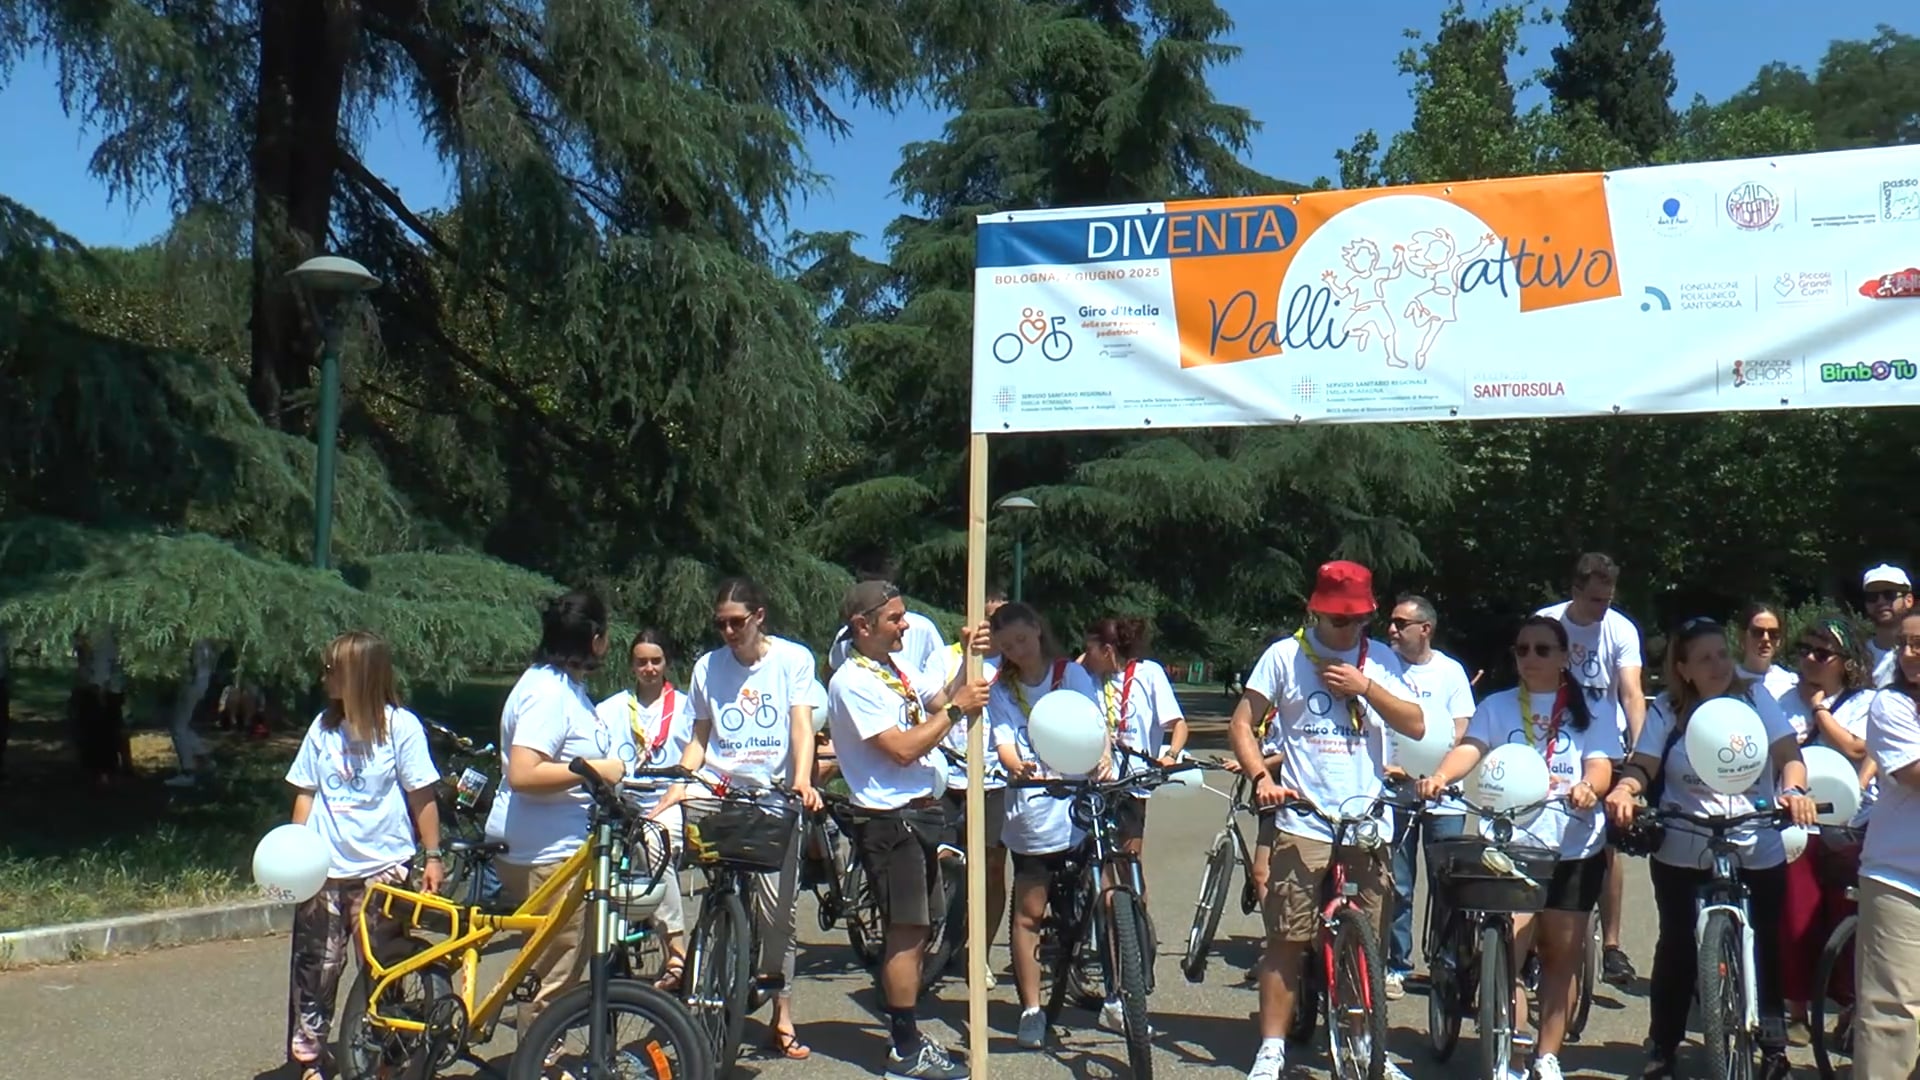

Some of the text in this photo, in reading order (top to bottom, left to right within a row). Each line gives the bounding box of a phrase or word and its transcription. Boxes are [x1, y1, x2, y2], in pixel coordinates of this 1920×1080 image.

[1883, 178, 1919, 191] passo
[1087, 209, 1286, 259] DIVENTA
[1460, 235, 1613, 299] attivo
[1074, 268, 1126, 282] GIUGNO
[1129, 267, 1160, 278] 2025
[1799, 271, 1831, 280] Piccoli
[1680, 281, 1739, 291] FONDAZIONE
[1798, 279, 1832, 289] Grandi
[1680, 290, 1737, 300] POLICLINICO
[1078, 304, 1160, 318] Giro d'Italia
[1208, 284, 1350, 357] Palli
[1745, 359, 1793, 367] FONDAZIONE
[1745, 366, 1793, 382] CHOPS
[1473, 381, 1565, 399] SANT'ORSOLA
[1303, 724, 1328, 735] Giro
[718, 739, 742, 749] Giro
[1551, 763, 1574, 774] alia
